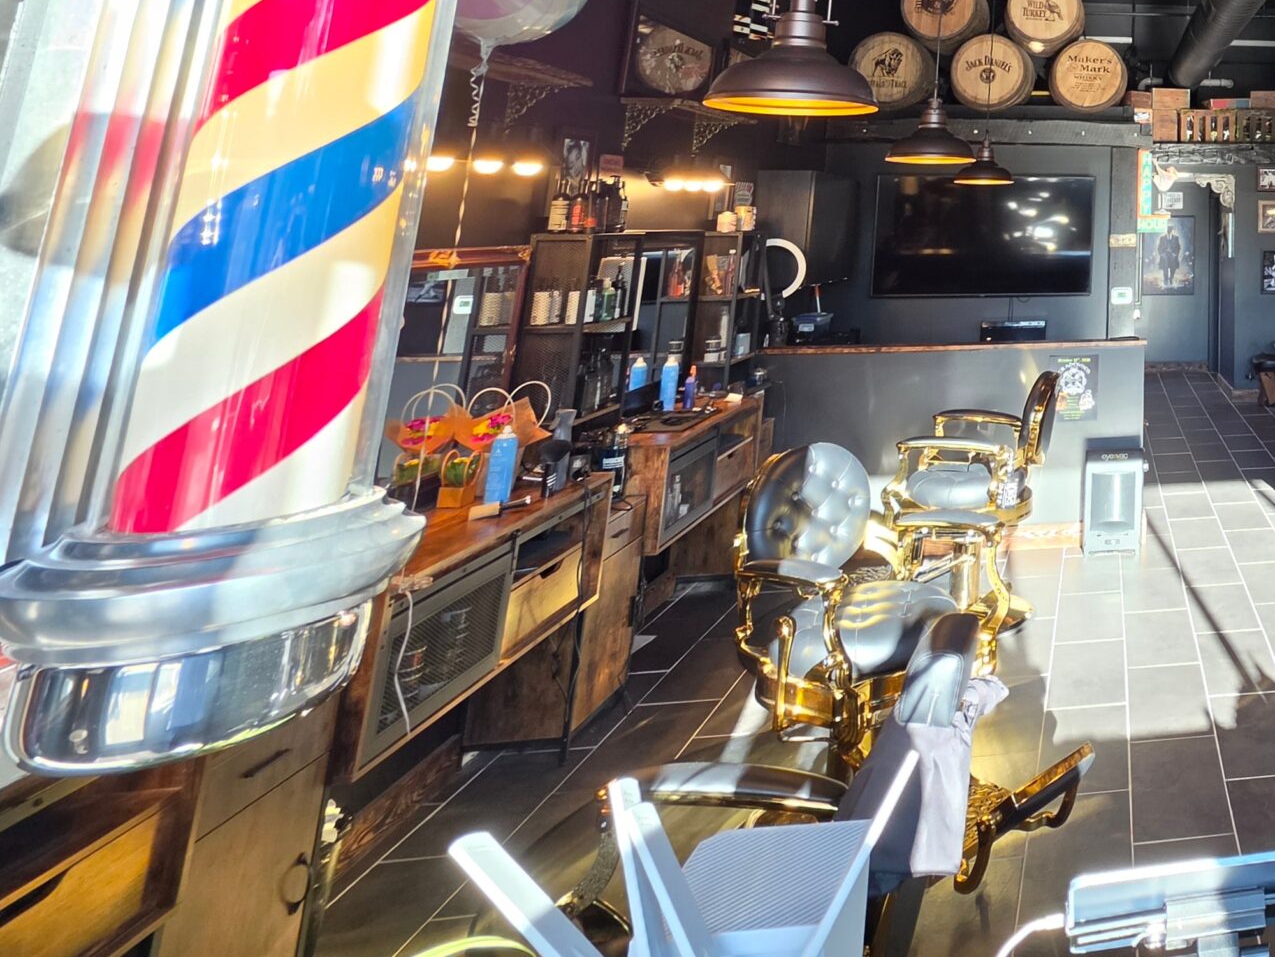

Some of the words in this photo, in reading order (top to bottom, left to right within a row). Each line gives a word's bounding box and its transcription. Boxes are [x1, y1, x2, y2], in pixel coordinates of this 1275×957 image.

[1027, 0, 1044, 9] WILD
[1022, 7, 1046, 18] TURKEY
[965, 58, 983, 72] JACK
[1080, 64, 1111, 74] Mark
